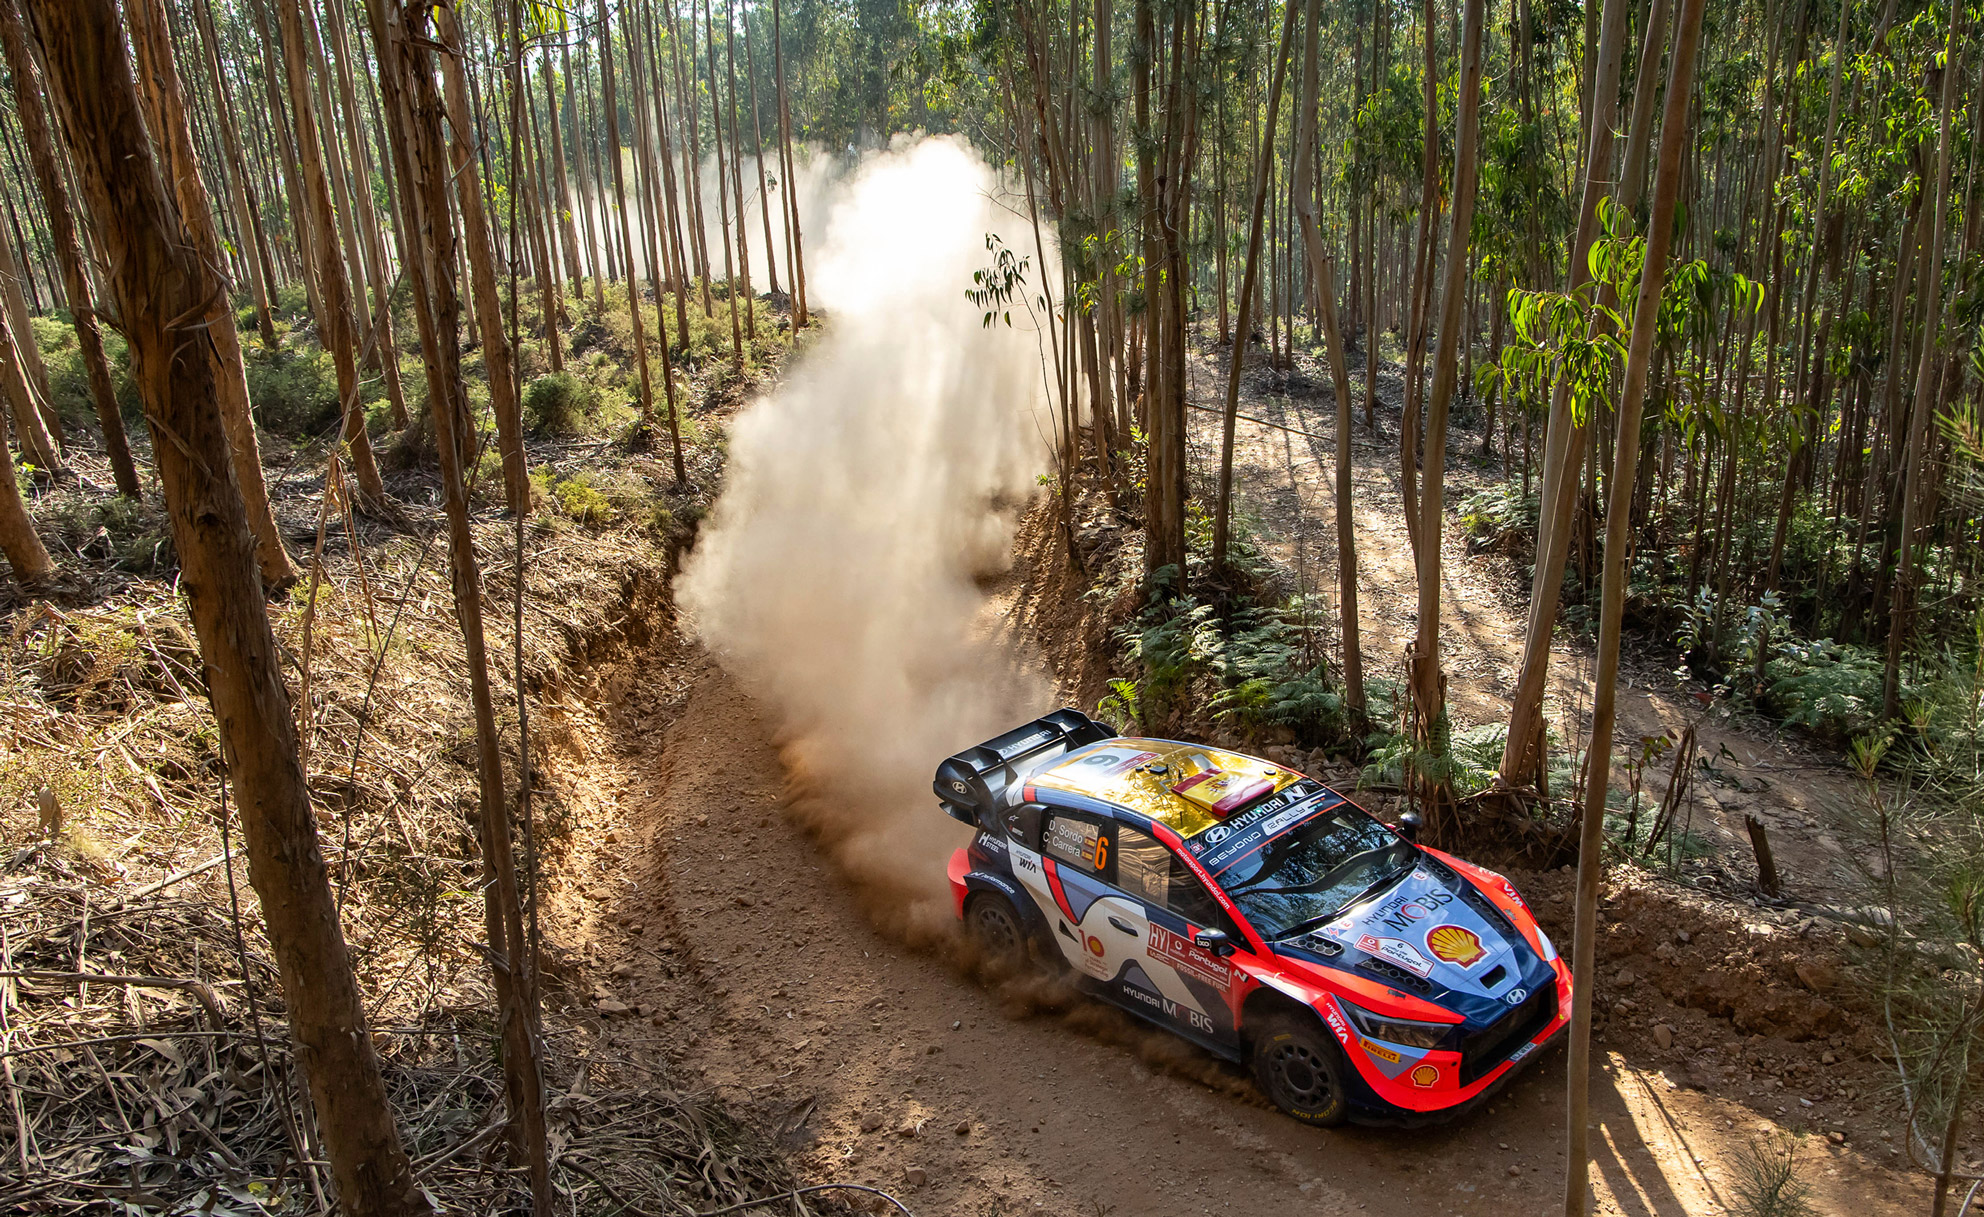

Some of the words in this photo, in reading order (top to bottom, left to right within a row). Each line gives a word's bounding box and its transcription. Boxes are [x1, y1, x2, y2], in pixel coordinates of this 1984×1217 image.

[1008, 729, 1052, 752] HYUNDAI
[1230, 797, 1285, 830] HYUNDAI
[989, 836, 1008, 850] HYUNDAI
[1042, 831, 1051, 844] C.
[1052, 836, 1081, 857] Carrera
[1048, 819, 1057, 833] D.
[1058, 824, 1084, 845] Sordo
[1209, 831, 1262, 867] BEYOND
[1267, 806, 1306, 830] RALLY
[985, 841, 1000, 853] STEEL
[1094, 836, 1109, 871] 6
[1176, 847, 1231, 910] motorsport.hyundai.com
[1361, 895, 1409, 926] HYUNDAI
[1381, 888, 1454, 933] MOBIS
[1188, 950, 1229, 976] Portugal
[1212, 979, 1227, 993] FUEL
[1123, 985, 1161, 1009] HYUNDAI
[1162, 998, 1214, 1034] MOBIS
[1326, 1002, 1346, 1027] HYUNDAI
[1362, 1040, 1397, 1062] PIRELLI
